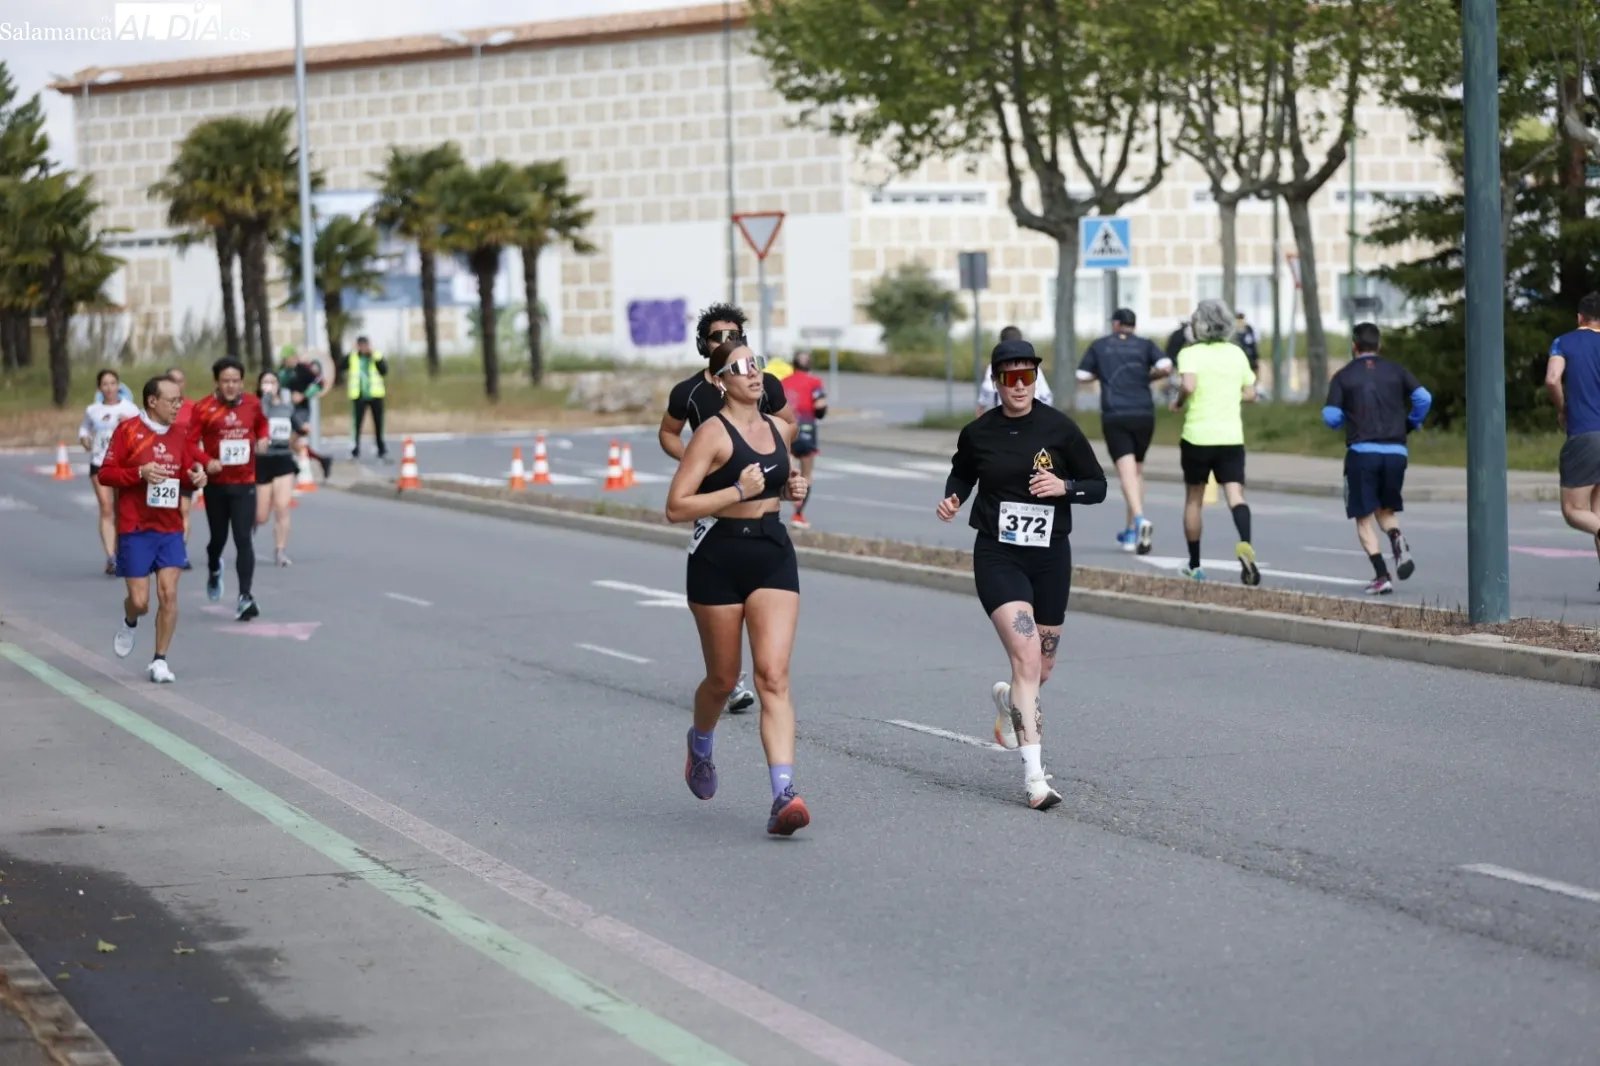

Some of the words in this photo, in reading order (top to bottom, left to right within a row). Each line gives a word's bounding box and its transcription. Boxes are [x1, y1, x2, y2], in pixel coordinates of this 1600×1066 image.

[224, 446, 246, 457] 327
[152, 486, 176, 499] 326
[1005, 514, 1047, 535] 372
